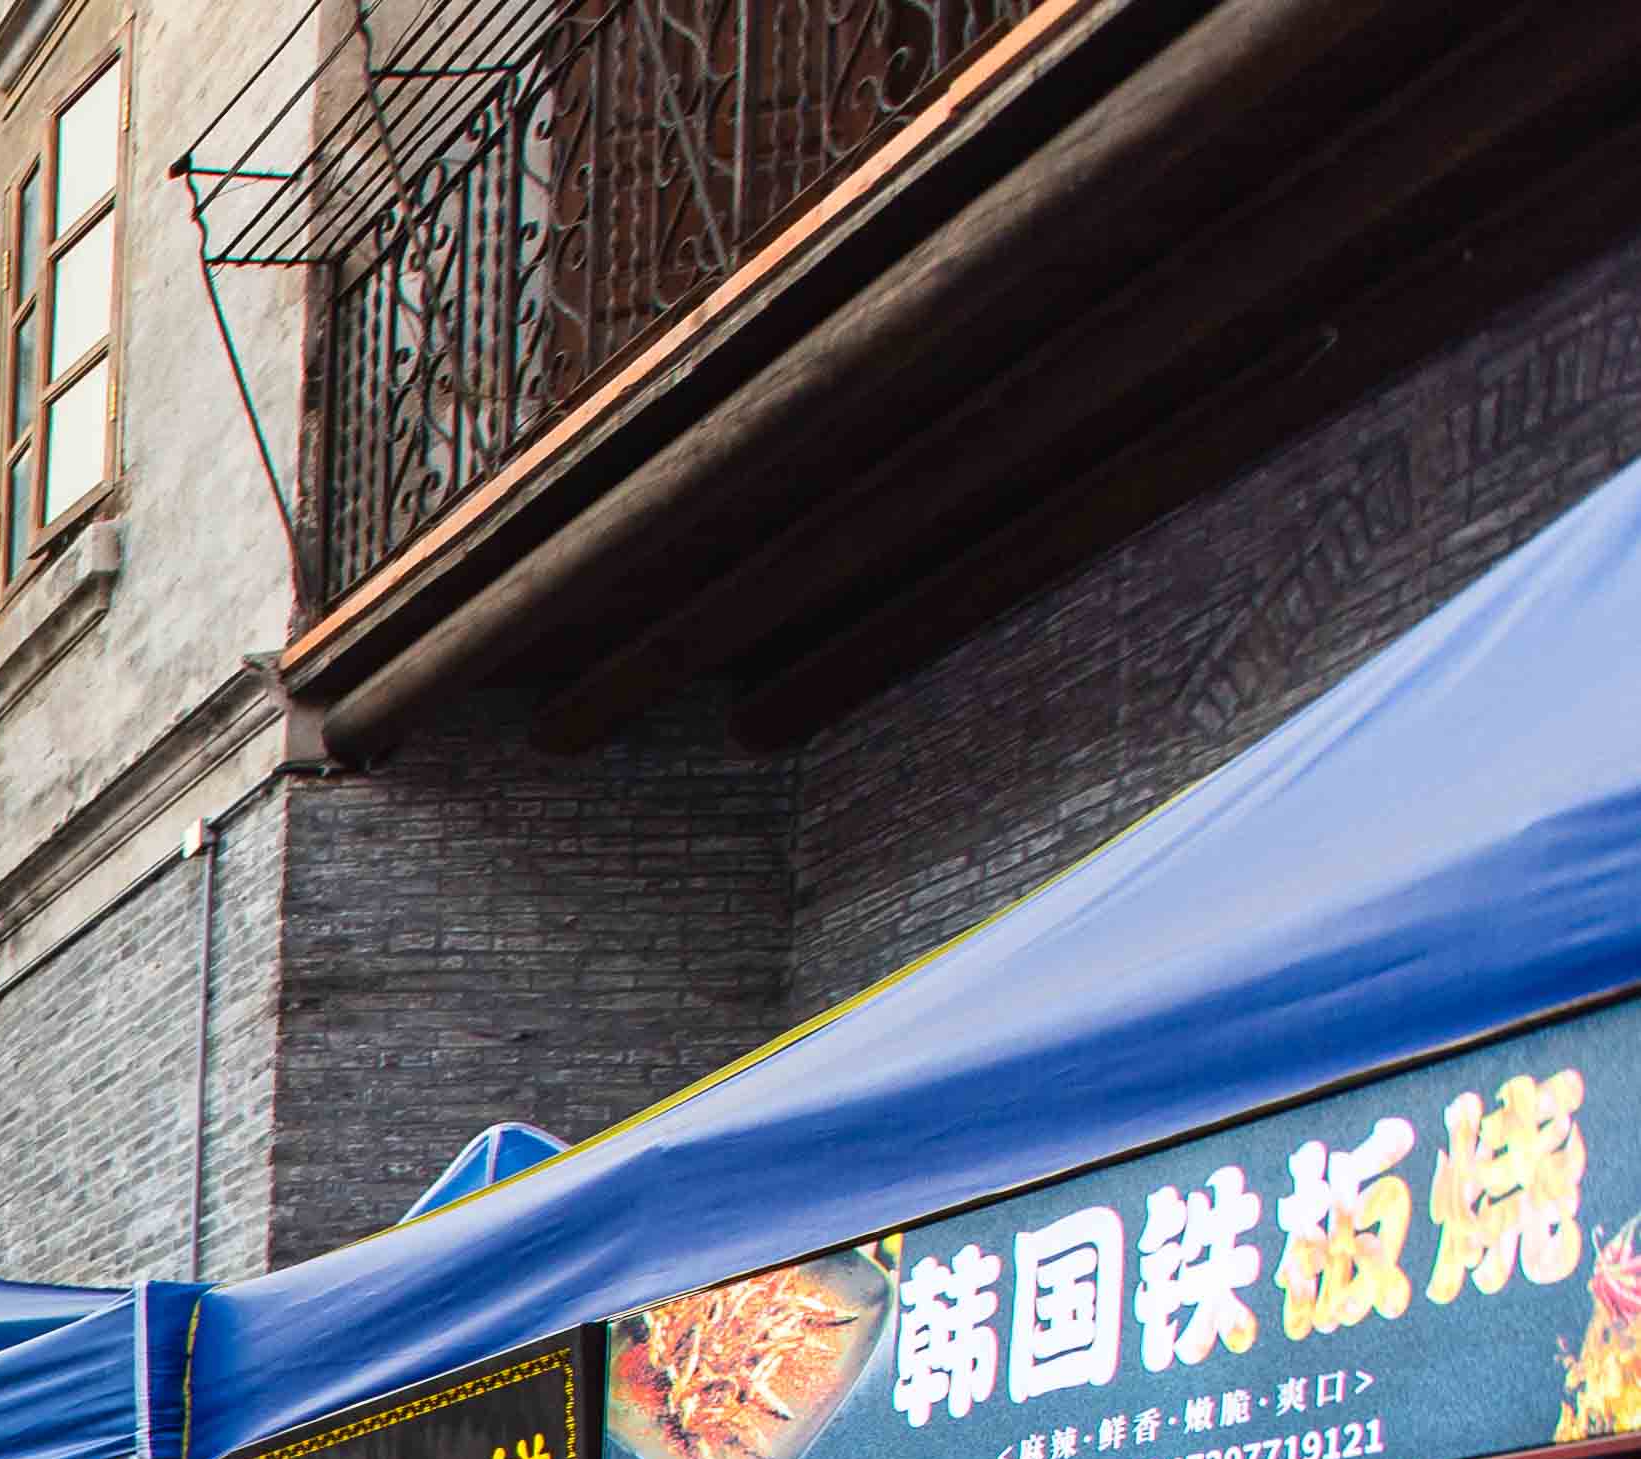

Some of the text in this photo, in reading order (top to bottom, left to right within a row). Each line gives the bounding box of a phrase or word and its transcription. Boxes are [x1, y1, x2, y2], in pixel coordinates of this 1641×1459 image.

[892, 1067, 1588, 1429] 韩国铁板烧
